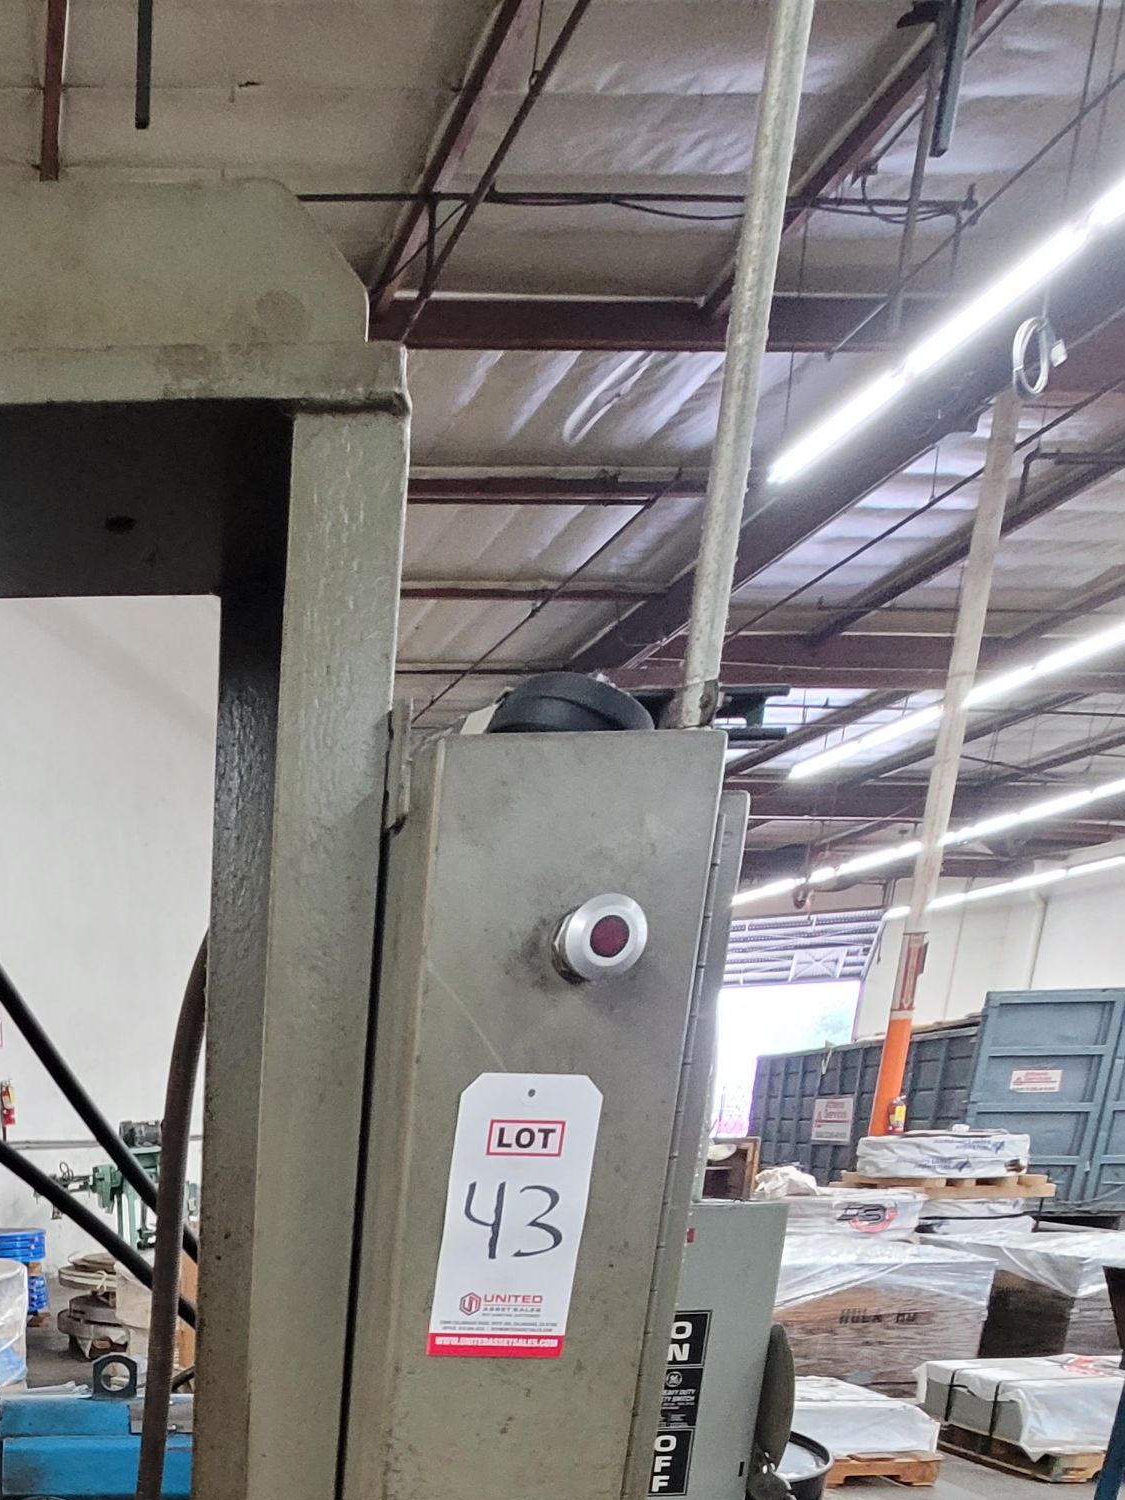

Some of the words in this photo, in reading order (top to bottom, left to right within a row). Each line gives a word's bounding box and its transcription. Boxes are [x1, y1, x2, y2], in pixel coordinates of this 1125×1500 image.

[496, 1127, 556, 1149] LOT
[463, 1181, 563, 1259] 43
[483, 1294, 543, 1304] UNITED
